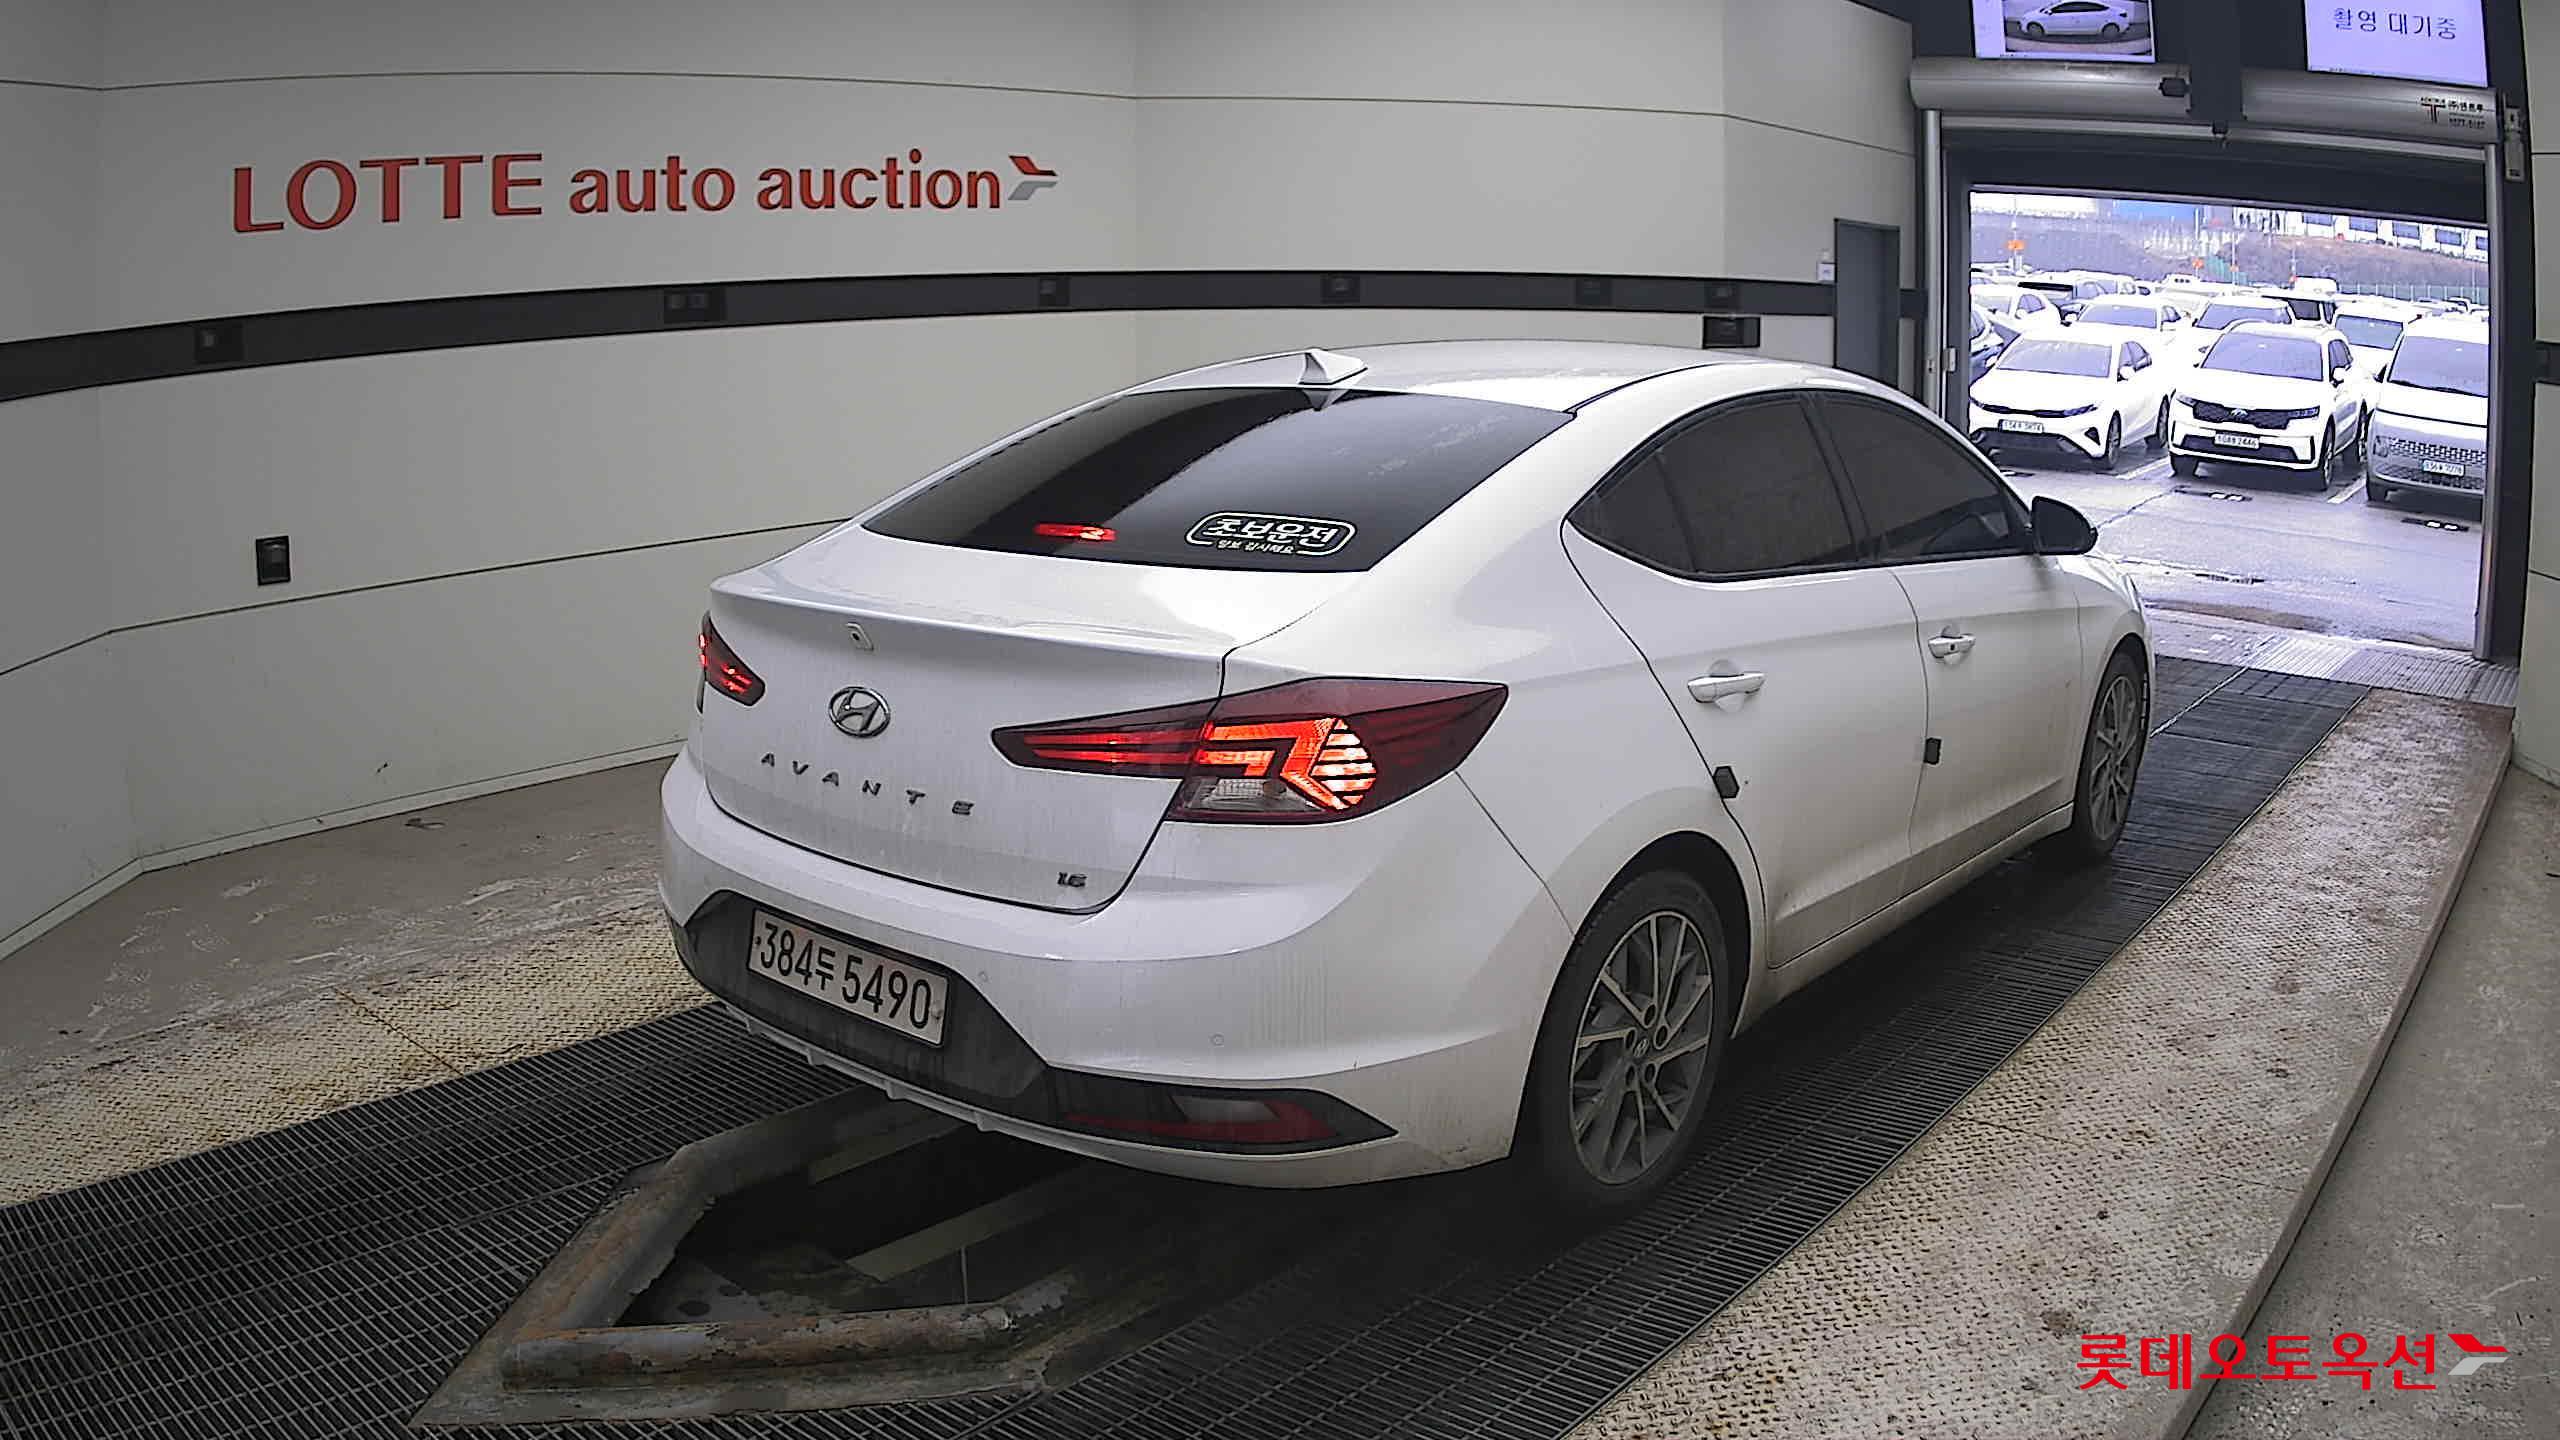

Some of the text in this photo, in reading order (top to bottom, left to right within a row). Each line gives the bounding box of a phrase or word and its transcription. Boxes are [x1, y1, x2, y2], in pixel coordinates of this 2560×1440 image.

[2334, 8, 2457, 40] 촬영 대기중
[233, 147, 1002, 233] LOTTE auto auction
[1202, 518, 1339, 548] 초보운전
[760, 752, 975, 816] AVANTE
